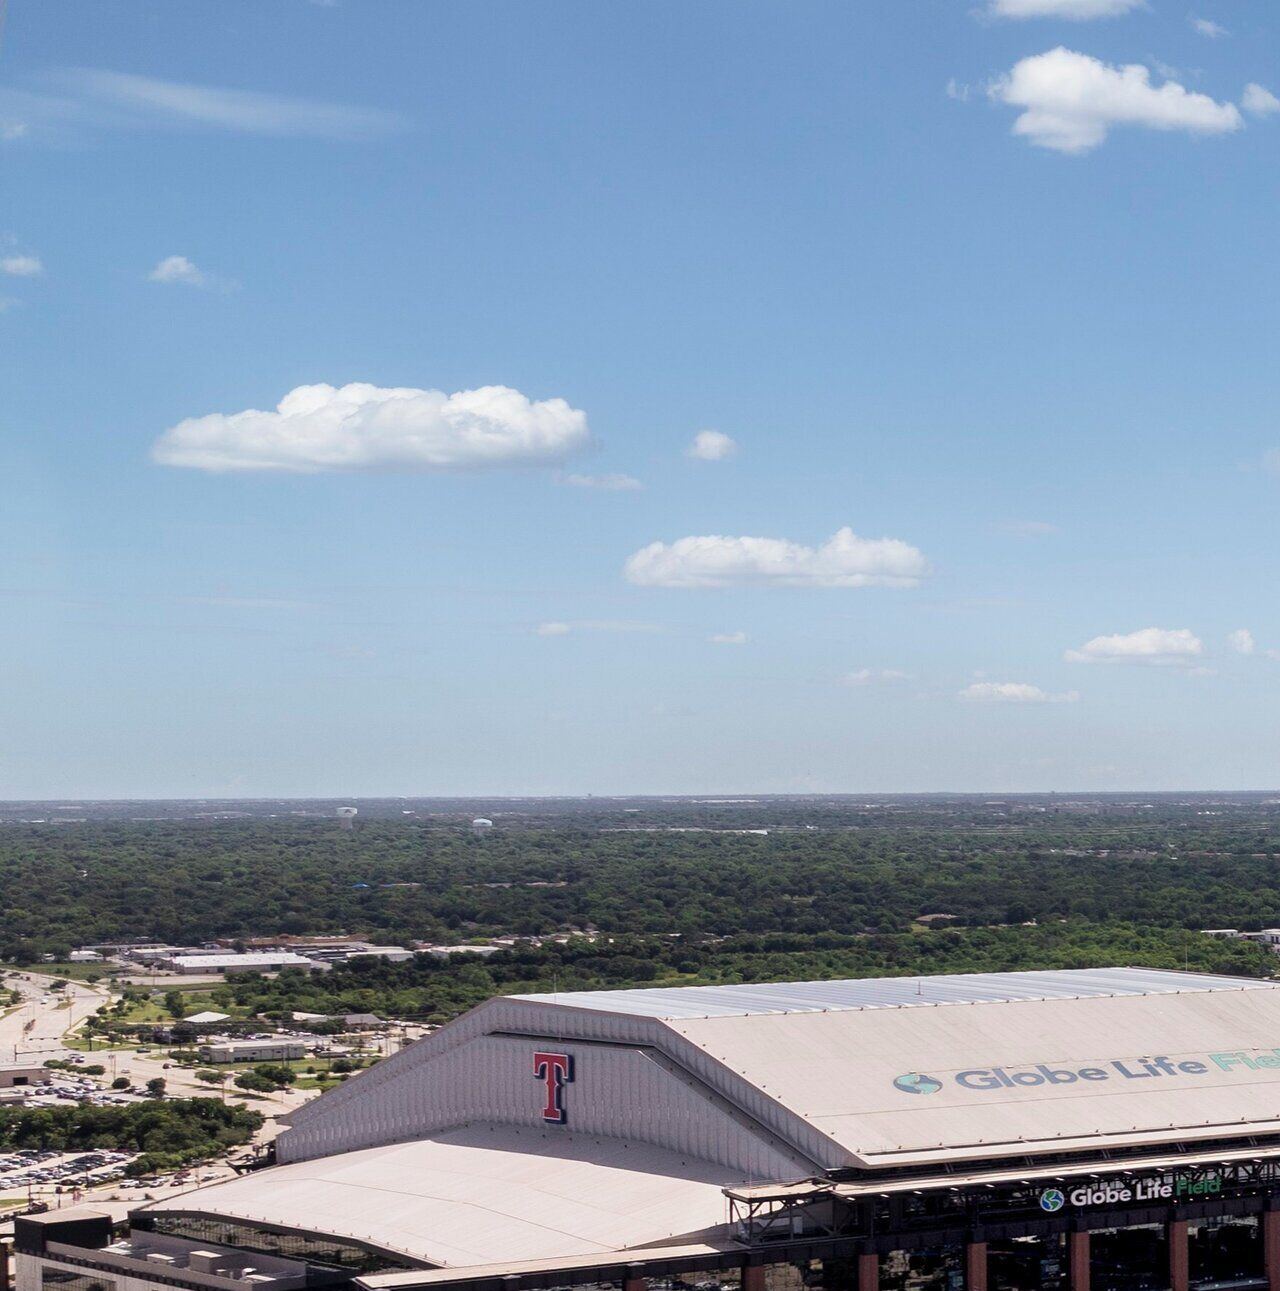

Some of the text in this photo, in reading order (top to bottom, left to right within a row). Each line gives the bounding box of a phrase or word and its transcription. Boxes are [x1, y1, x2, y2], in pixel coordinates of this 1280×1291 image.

[533, 1052, 573, 1123] T
[954, 1065, 1109, 1091] Globe
[1111, 1056, 1208, 1080] Life
[1070, 1177, 1222, 1207] Globe Life Field
